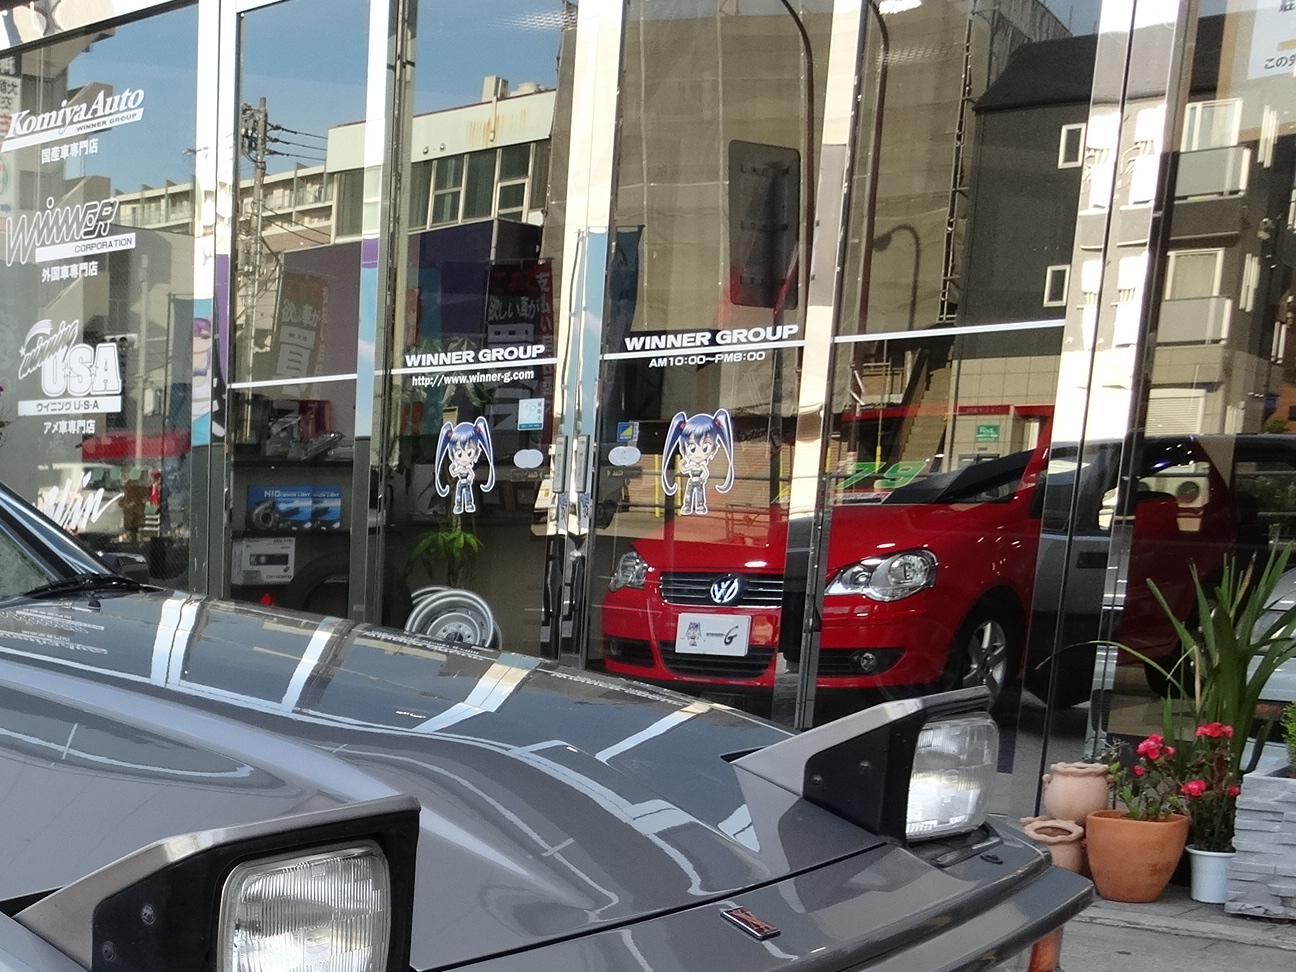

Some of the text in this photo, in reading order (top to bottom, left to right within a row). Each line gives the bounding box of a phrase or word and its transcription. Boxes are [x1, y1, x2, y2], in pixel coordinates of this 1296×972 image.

[76, 113, 137, 132] WINNER GROUP
[41, 138, 98, 164] 国産車専門店
[74, 237, 133, 253] CORPORATION
[41, 261, 98, 283] 外国車専門店
[624, 325, 799, 351] WINNER GROUP
[405, 344, 545, 367] WINNER GROUP
[412, 369, 534, 387] http://www.winner-g.com
[43, 419, 96, 435] アメ車専門店
[264, 490, 281, 498] HID
